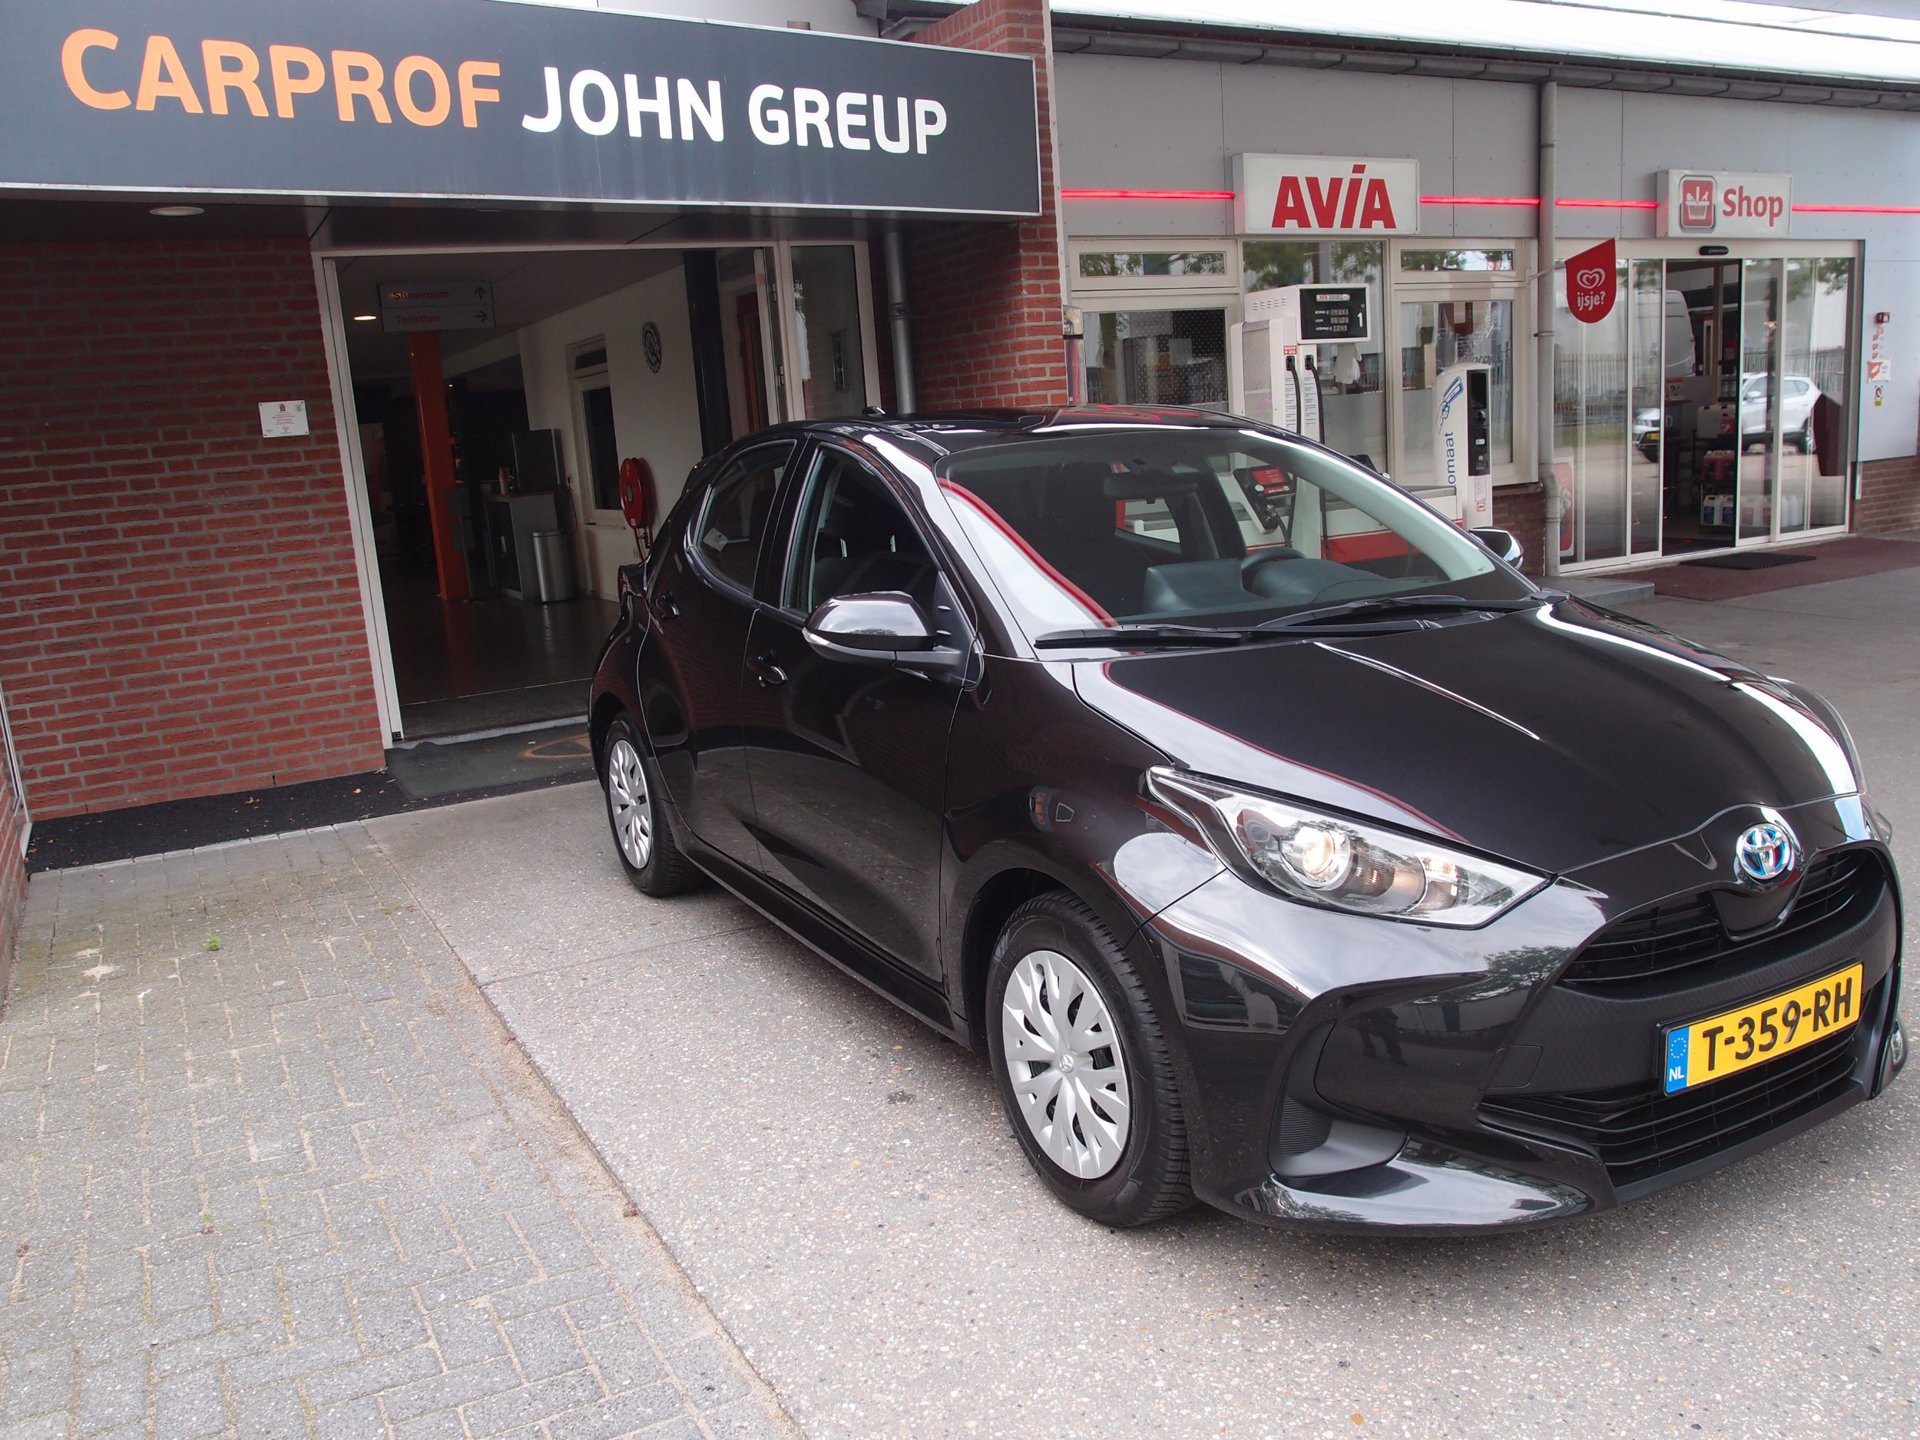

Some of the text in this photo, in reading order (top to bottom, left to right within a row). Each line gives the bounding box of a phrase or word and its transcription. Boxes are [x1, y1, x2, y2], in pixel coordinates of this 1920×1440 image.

[61, 28, 947, 155] CARPROF JOHN GREUP
[1722, 186, 1784, 227] Shop
[393, 290, 449, 301] Showroom
[1577, 291, 1606, 311] ijsje?
[1357, 312, 1363, 328] 1
[1444, 431, 1457, 485] omaat
[1702, 977, 1853, 1072] T-359-RH
[1668, 1065, 1685, 1082] NL
